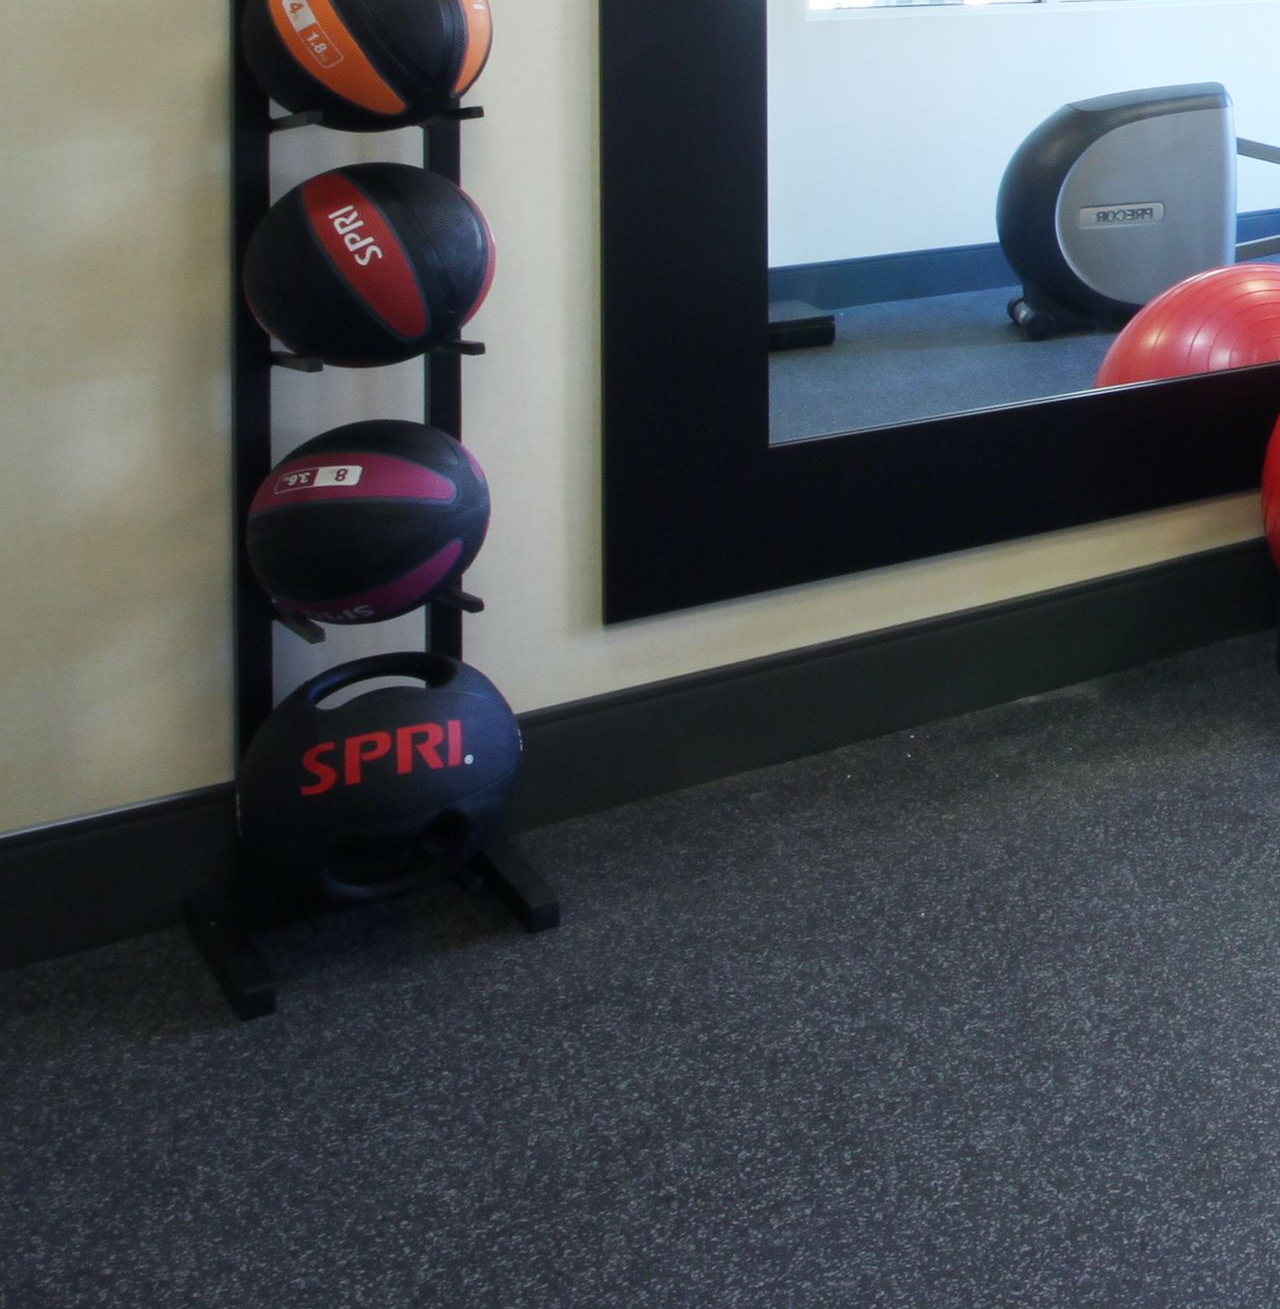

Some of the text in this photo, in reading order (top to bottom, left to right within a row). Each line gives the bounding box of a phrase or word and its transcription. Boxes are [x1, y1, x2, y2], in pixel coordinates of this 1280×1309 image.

[307, 32, 327, 53] 1.8
[328, 205, 382, 266] SPRI
[334, 468, 348, 481] 8
[301, 719, 463, 795] SPRI
